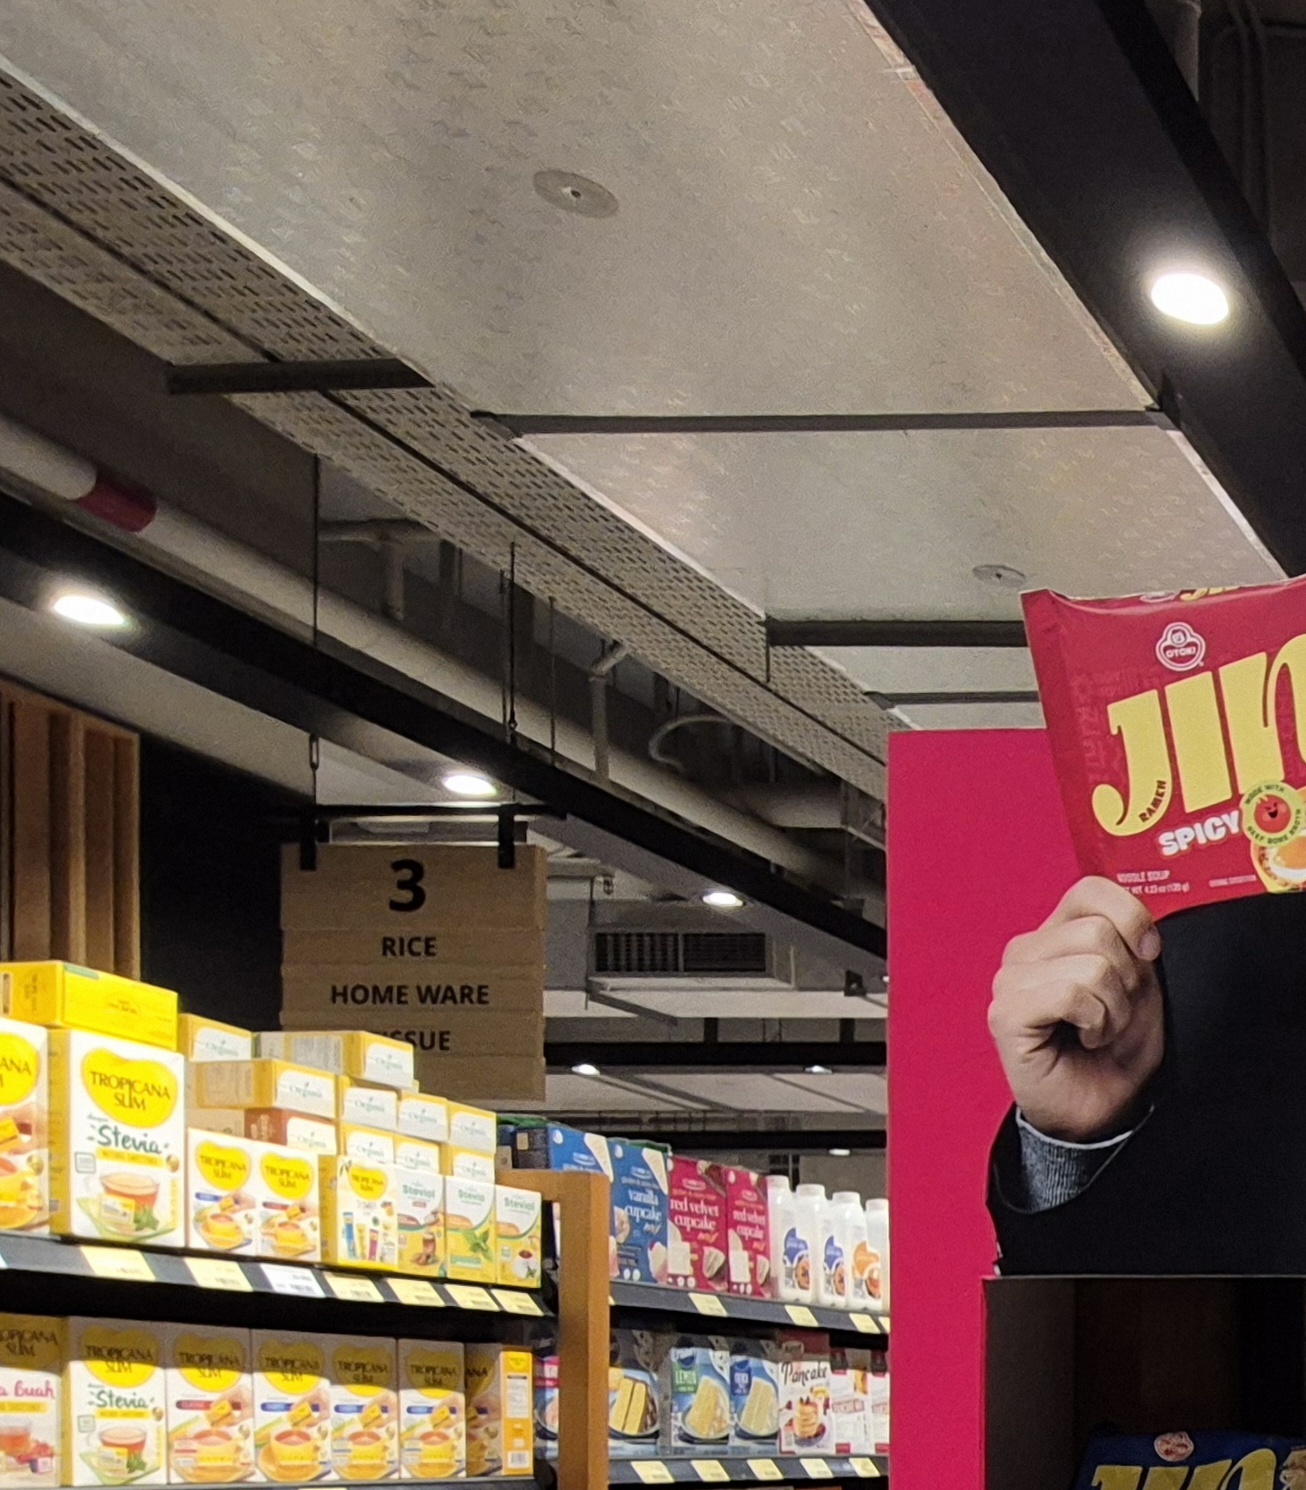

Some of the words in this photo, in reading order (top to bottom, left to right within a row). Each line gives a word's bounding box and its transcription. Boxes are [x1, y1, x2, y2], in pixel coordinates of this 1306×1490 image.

[1139, 780, 1167, 823] RAMEN
[1158, 810, 1240, 857] SPICY
[389, 858, 427, 912] 3
[382, 936, 437, 957] RICE
[331, 984, 408, 1005] HOME
[416, 984, 490, 1005] WARE
[90, 1071, 170, 1100] TROPICANA
[114, 1092, 146, 1111] SLIM
[97, 1125, 163, 1155] Stevia
[200, 1155, 247, 1172] TROPICANA
[265, 1166, 310, 1183] TROPICANA
[670, 1198, 688, 1212] red
[689, 1200, 719, 1217] velvet
[674, 1214, 717, 1232] cupcake
[780, 1361, 829, 1387] Pancake
[14, 1380, 55, 1398] Buah
[96, 1389, 149, 1409] Stevia
